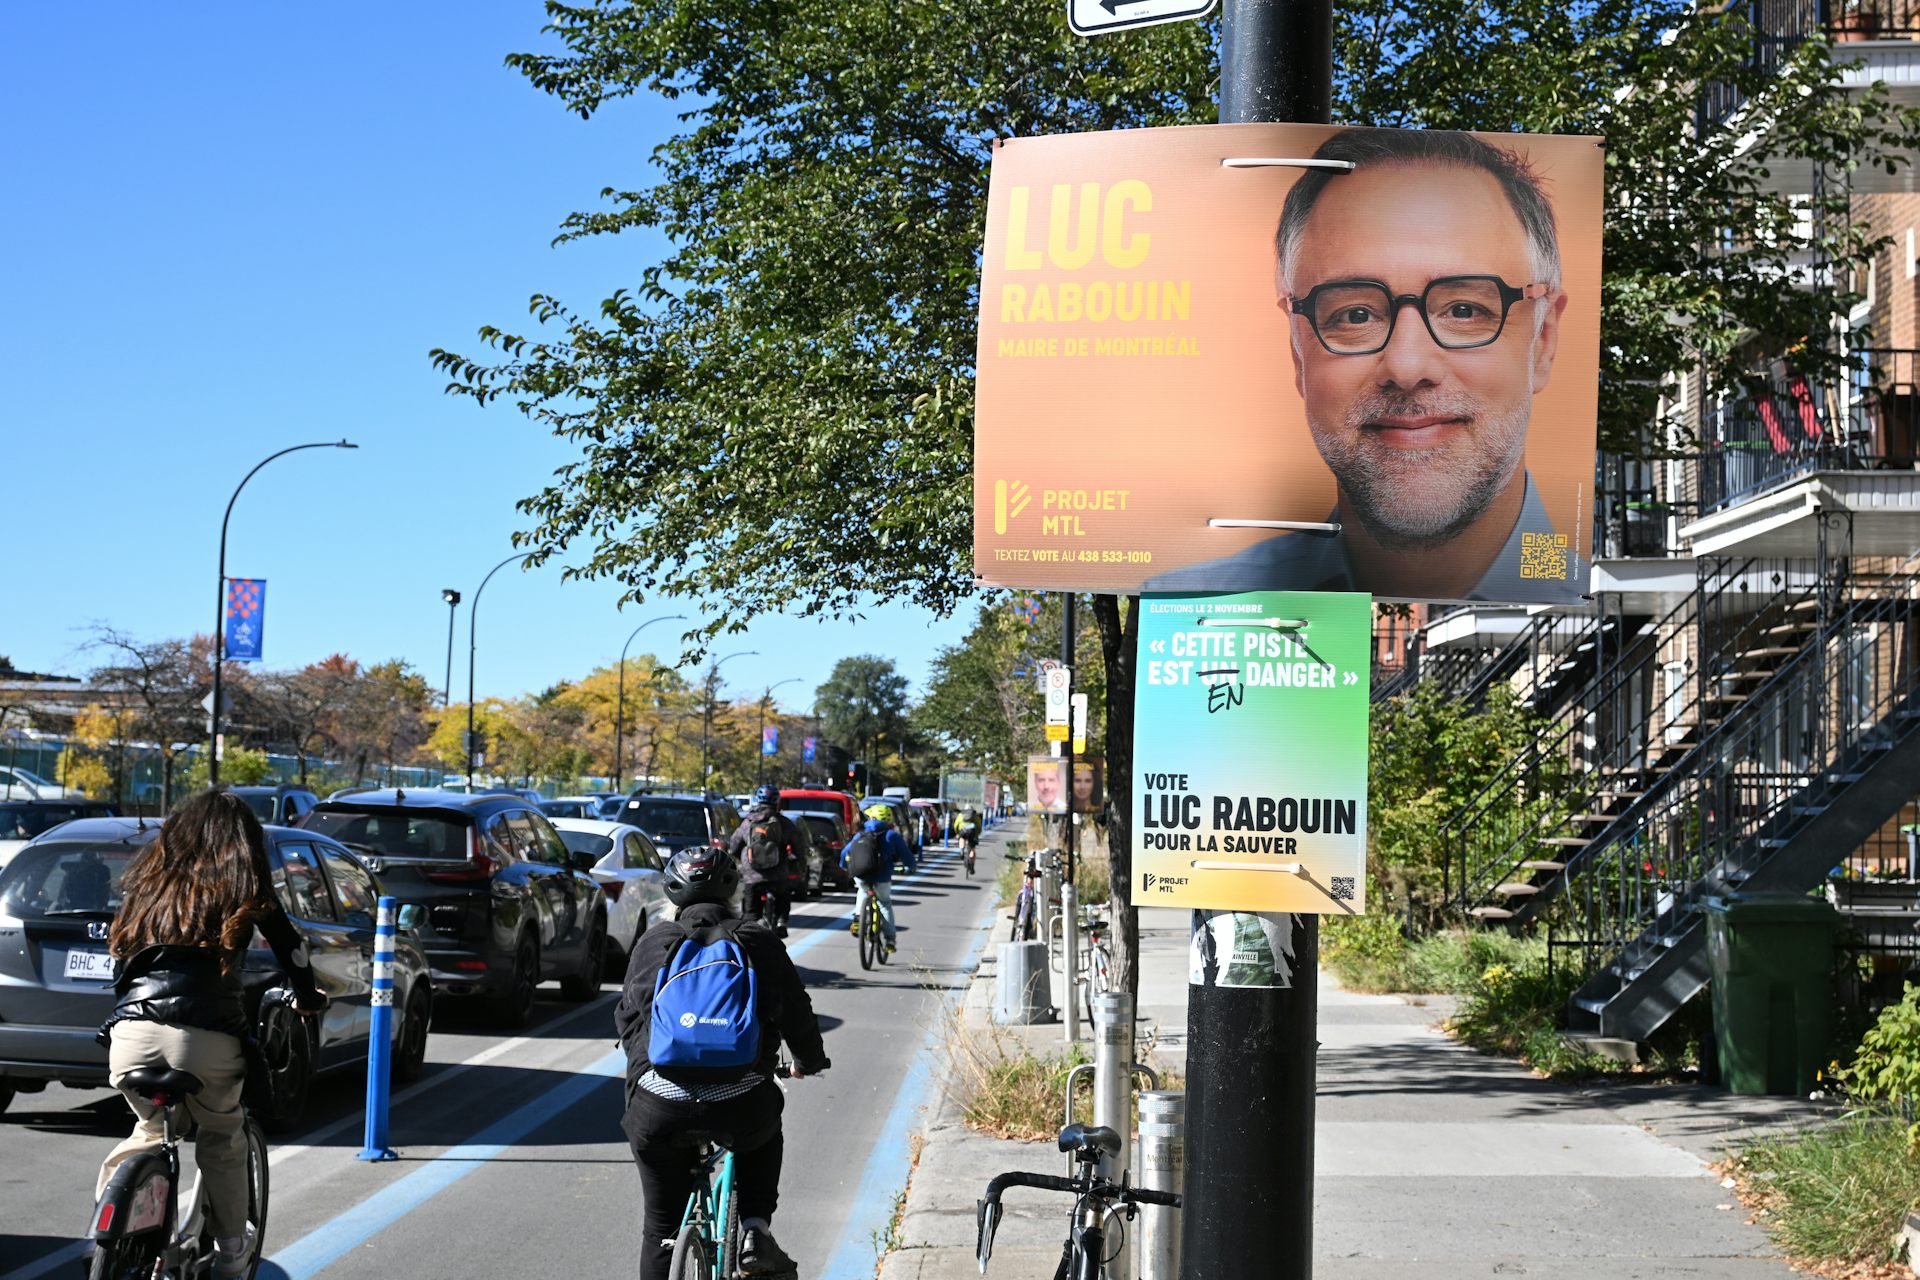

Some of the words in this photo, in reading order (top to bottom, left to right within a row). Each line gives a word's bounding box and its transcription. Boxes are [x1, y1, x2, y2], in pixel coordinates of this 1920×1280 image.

[1004, 179, 1153, 271] LUC
[1000, 280, 1191, 323] RABOUIN
[998, 338, 1058, 357] MAIRE
[1064, 337, 1089, 356] DE
[1096, 332, 1200, 356] MONTRÉAL
[1042, 489, 1131, 511] PROJET
[1042, 515, 1086, 536] MTL
[994, 549, 1030, 561] TEXTEZ
[1032, 549, 1059, 562] VOTE
[1061, 550, 1076, 562] AU
[1077, 550, 1100, 562] 438
[1102, 550, 1152, 563] 533-1010
[1149, 602, 1194, 614] ÉLECTIONS
[1196, 604, 1205, 614] LE
[1207, 604, 1213, 614] 2
[1215, 604, 1263, 614] NOVEMBRE
[1171, 631, 1236, 657] CETTE
[1243, 632, 1308, 659] PISTE
[1148, 660, 1194, 686] EST
[1201, 661, 1237, 686] UN
[1246, 661, 1336, 688] DANGER
[1207, 682, 1244, 713] EN
[1144, 773, 1189, 791] VOTE
[1144, 794, 1201, 830] LUC
[1213, 796, 1356, 835] RABOUIN
[1143, 832, 1191, 851] POUR
[1196, 835, 1219, 852] LA
[1223, 836, 1297, 855] SAUVER
[1159, 877, 1189, 885] PROJET
[1159, 885, 1174, 893] MTL
[70, 954, 96, 971] BHC
